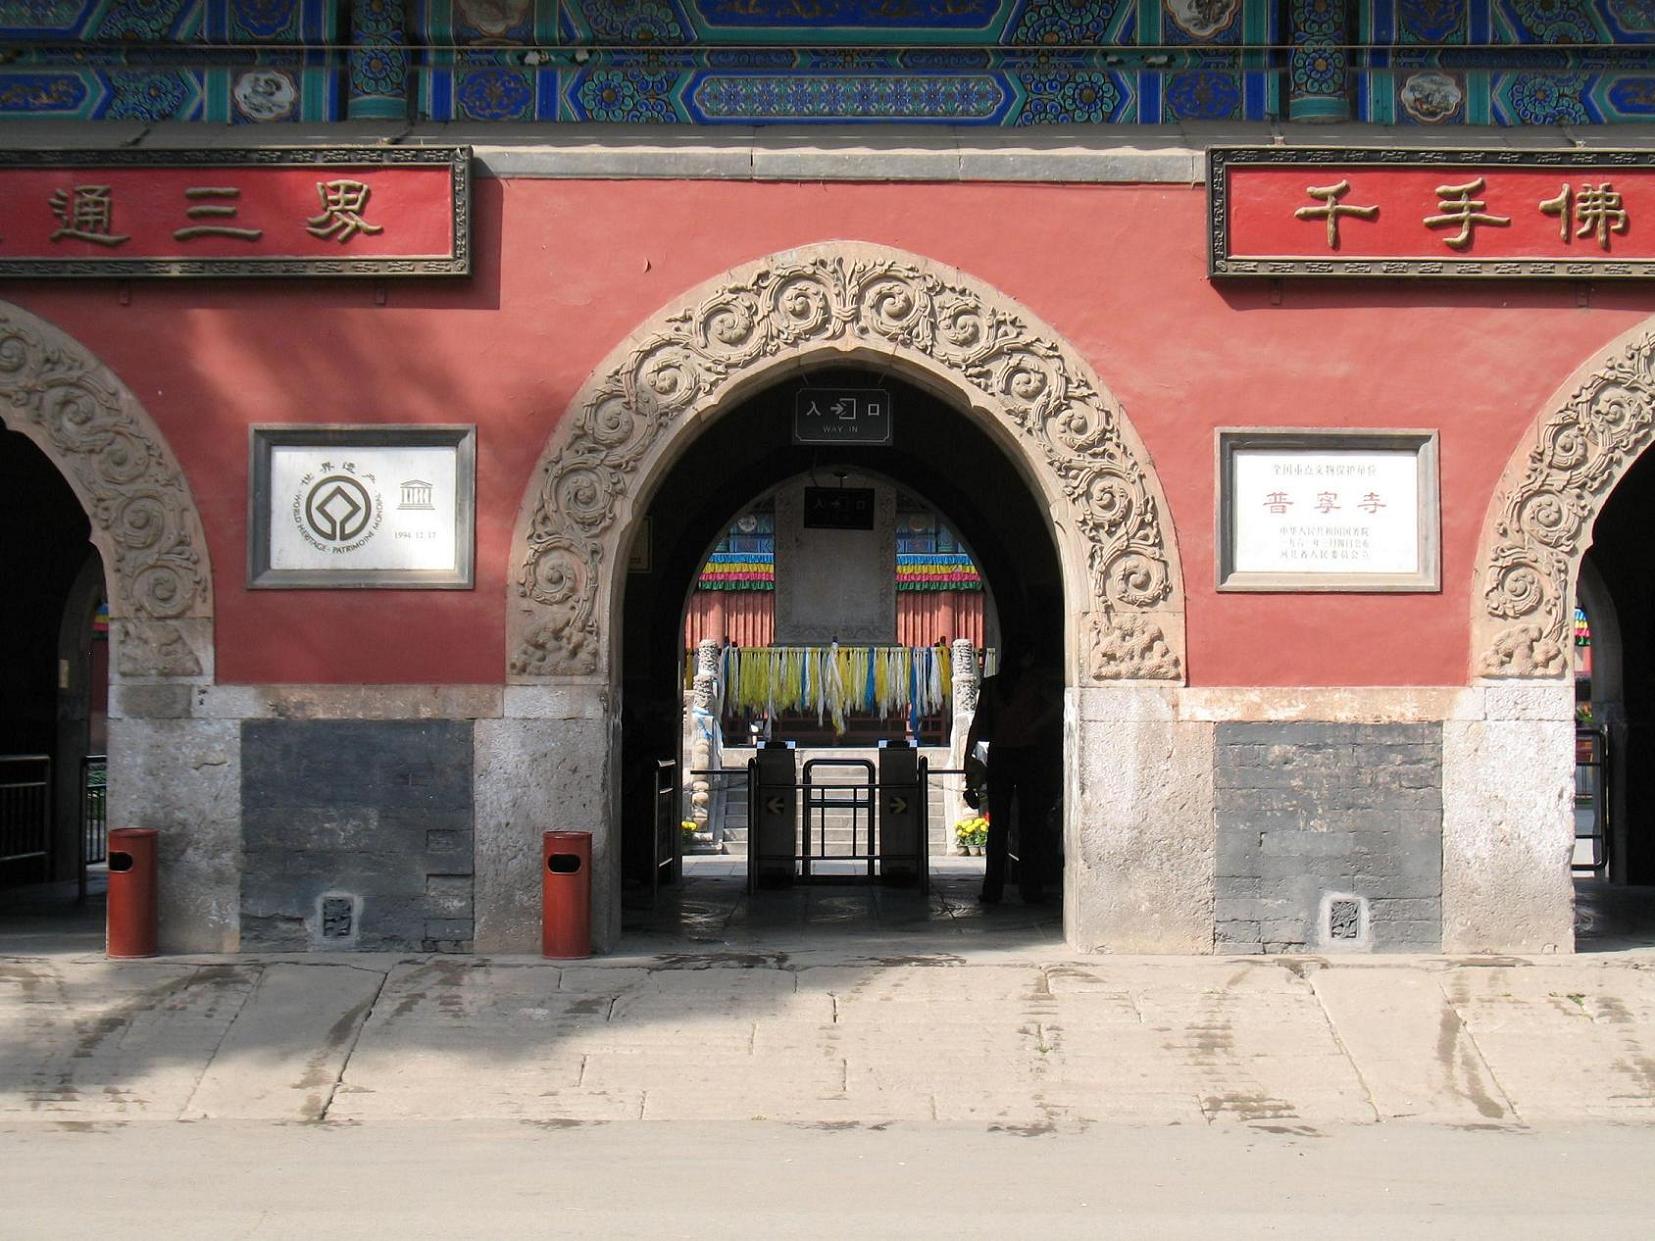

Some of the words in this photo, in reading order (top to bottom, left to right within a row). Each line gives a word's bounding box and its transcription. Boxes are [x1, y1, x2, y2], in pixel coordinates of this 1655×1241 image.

[823, 425, 843, 433] WAY
[848, 425, 858, 433] IN
[293, 491, 303, 523] WORLD
[297, 523, 327, 552] HERITAGE
[332, 530, 374, 554] PATRIMOINE
